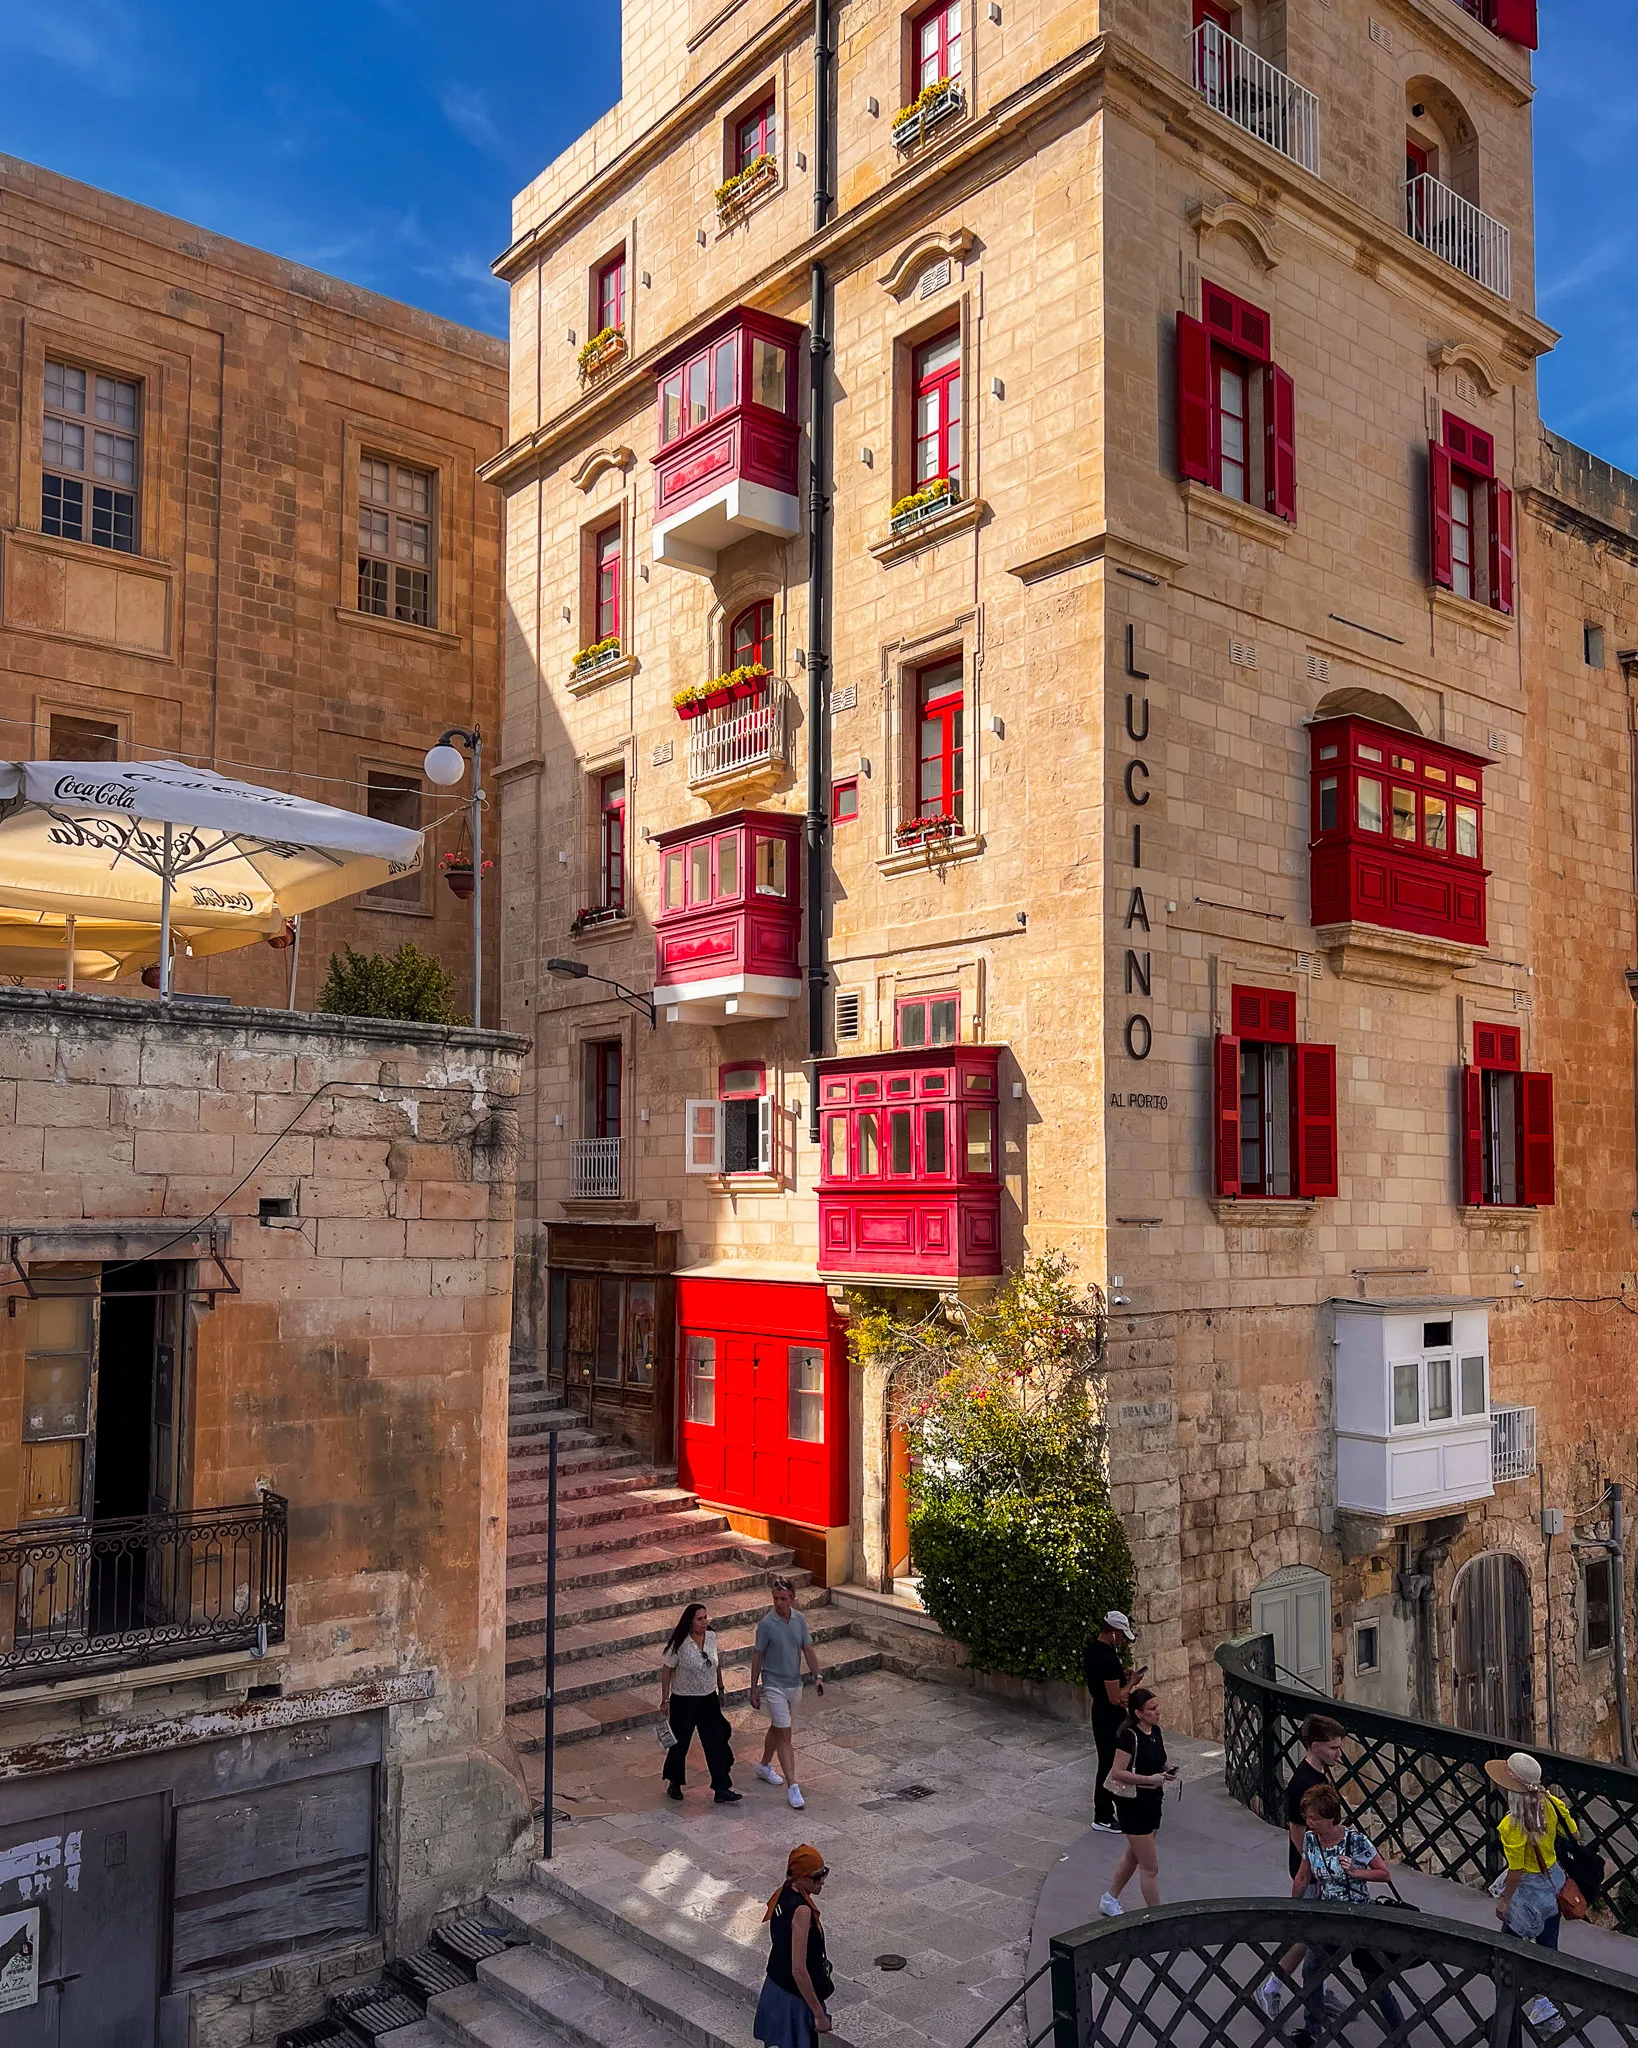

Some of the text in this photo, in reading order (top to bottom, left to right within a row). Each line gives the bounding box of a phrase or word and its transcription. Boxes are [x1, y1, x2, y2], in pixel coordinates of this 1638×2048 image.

[54, 775, 140, 810] Coca-Cola
[1125, 623, 1153, 1060] LUCIANO
[1111, 1093, 1168, 1110] AL PORTO
